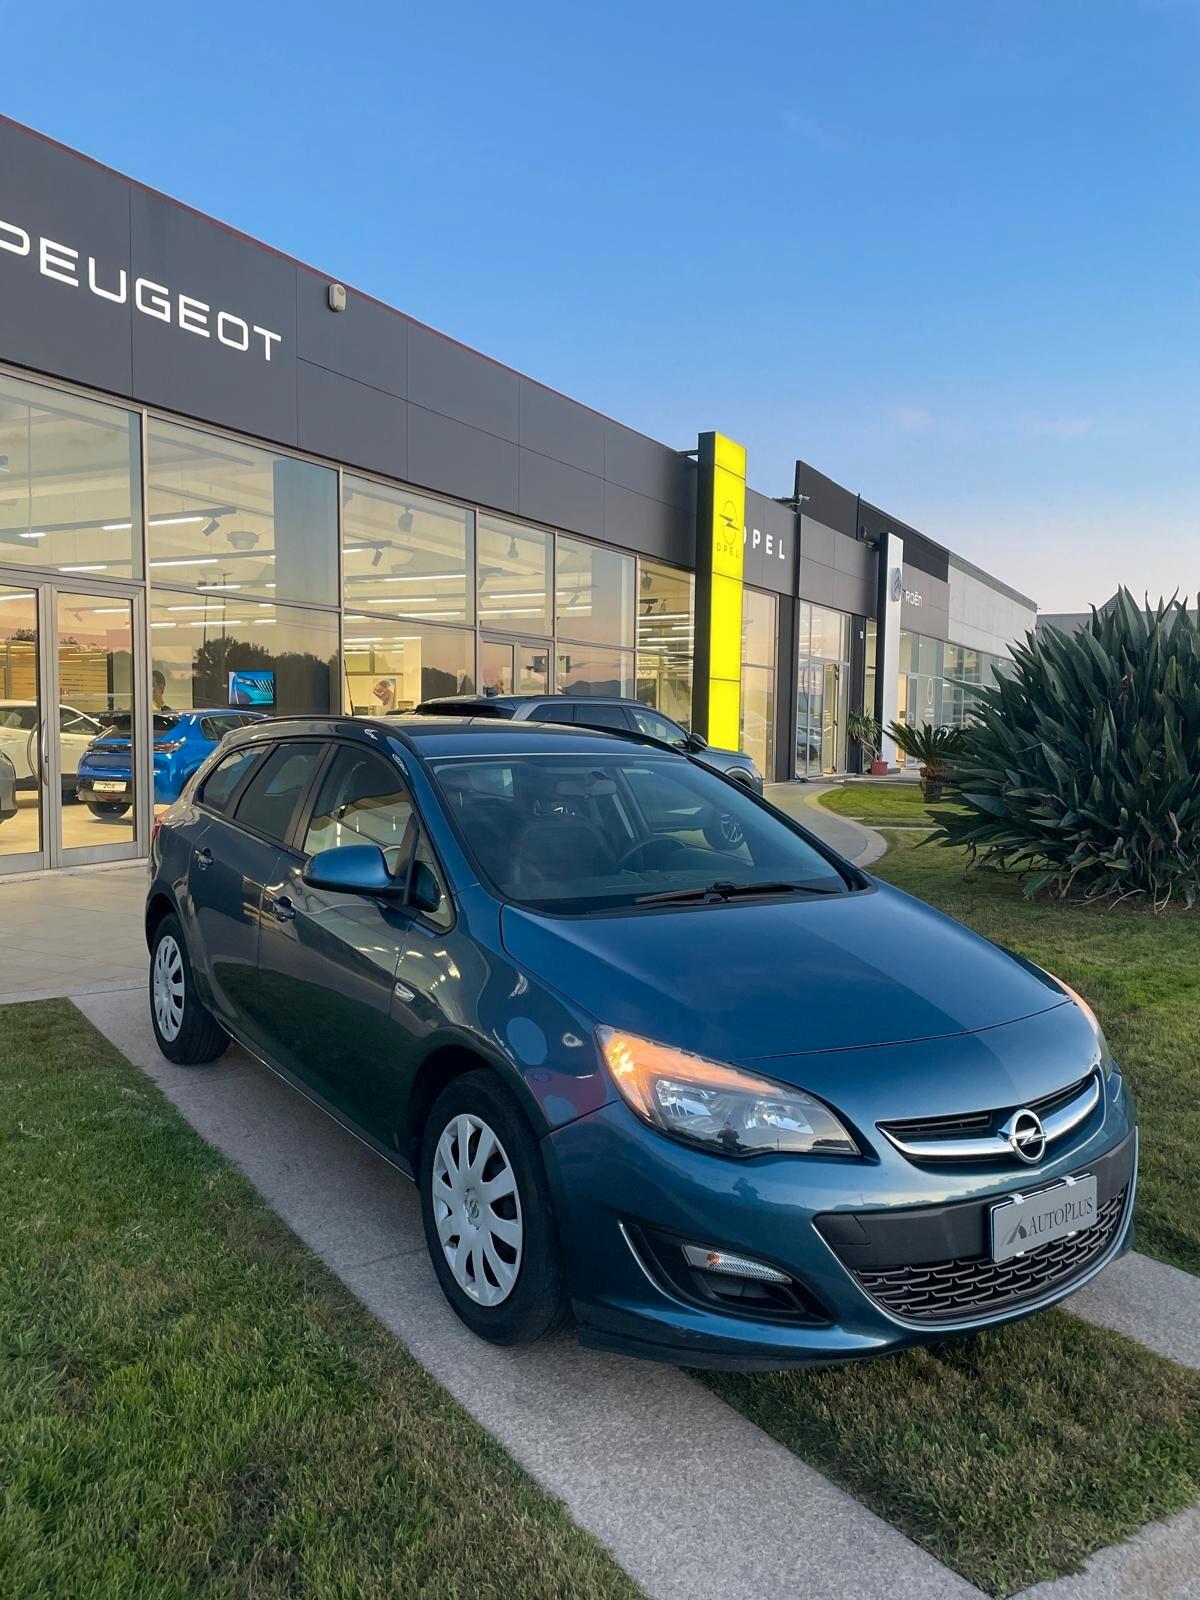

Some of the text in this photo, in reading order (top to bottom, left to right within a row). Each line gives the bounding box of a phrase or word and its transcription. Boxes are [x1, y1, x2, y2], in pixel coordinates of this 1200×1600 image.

[0, 220, 282, 361] PEUGEOT
[716, 542, 740, 559] OPEL
[743, 526, 785, 560] PEL
[1027, 1197, 1094, 1237] AUTOPLUS
